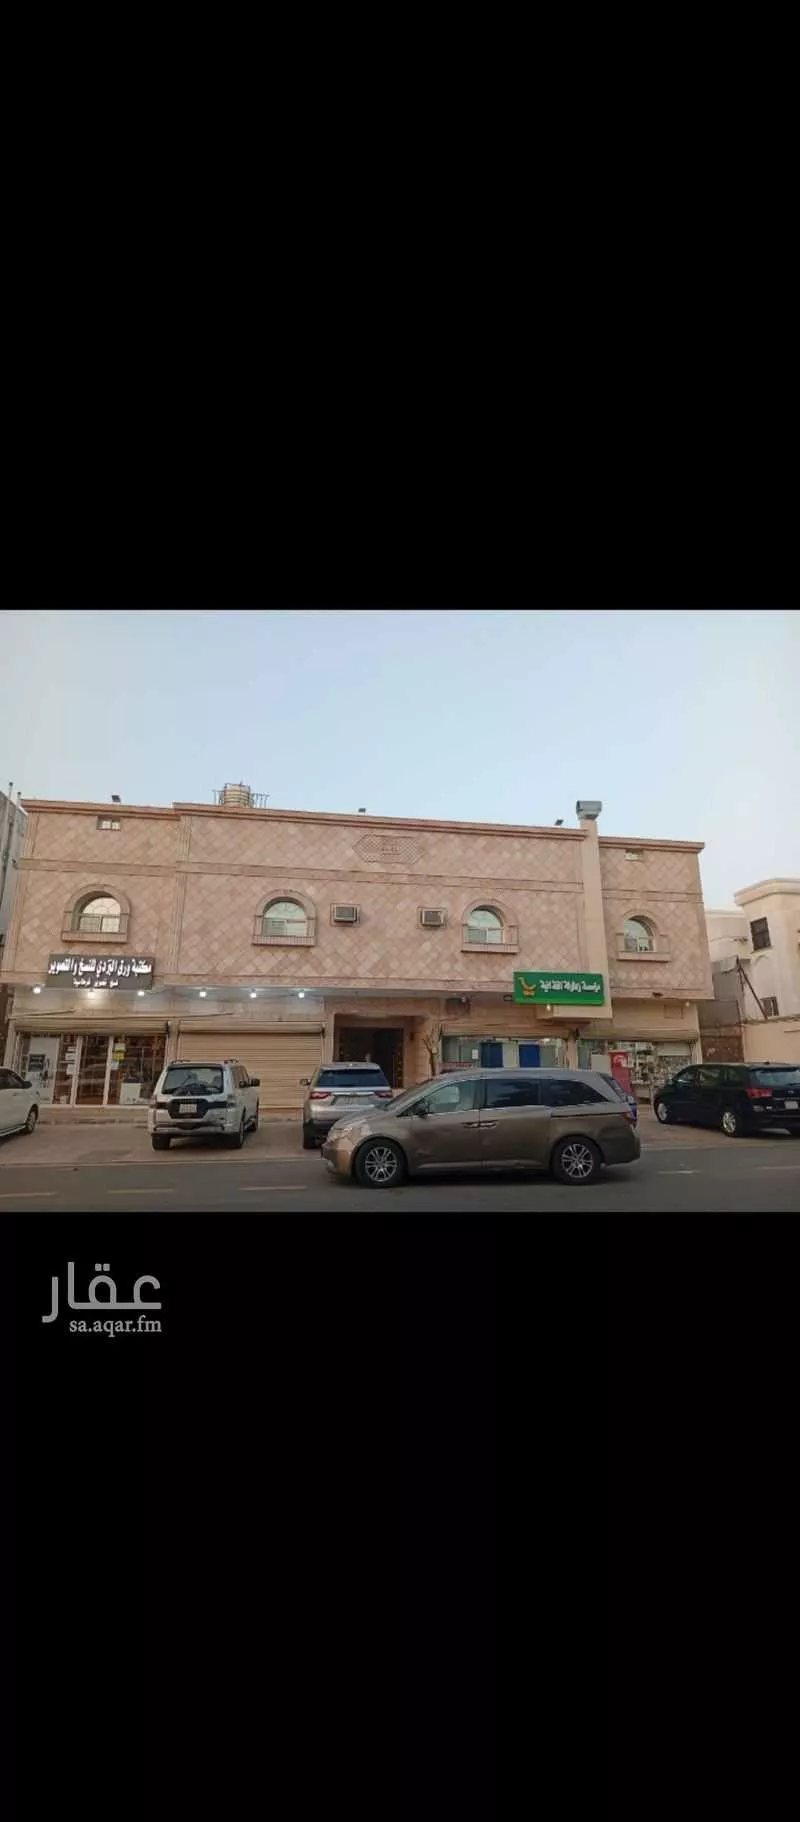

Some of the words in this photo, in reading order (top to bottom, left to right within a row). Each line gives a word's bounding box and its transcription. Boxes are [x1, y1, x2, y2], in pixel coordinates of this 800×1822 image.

[48, 957, 78, 975] والتصوير
[78, 958, 97, 976] للنسخ
[117, 960, 131, 977] ورق
[131, 958, 152, 976] مكتبة
[582, 981, 601, 993] مؤسسة
